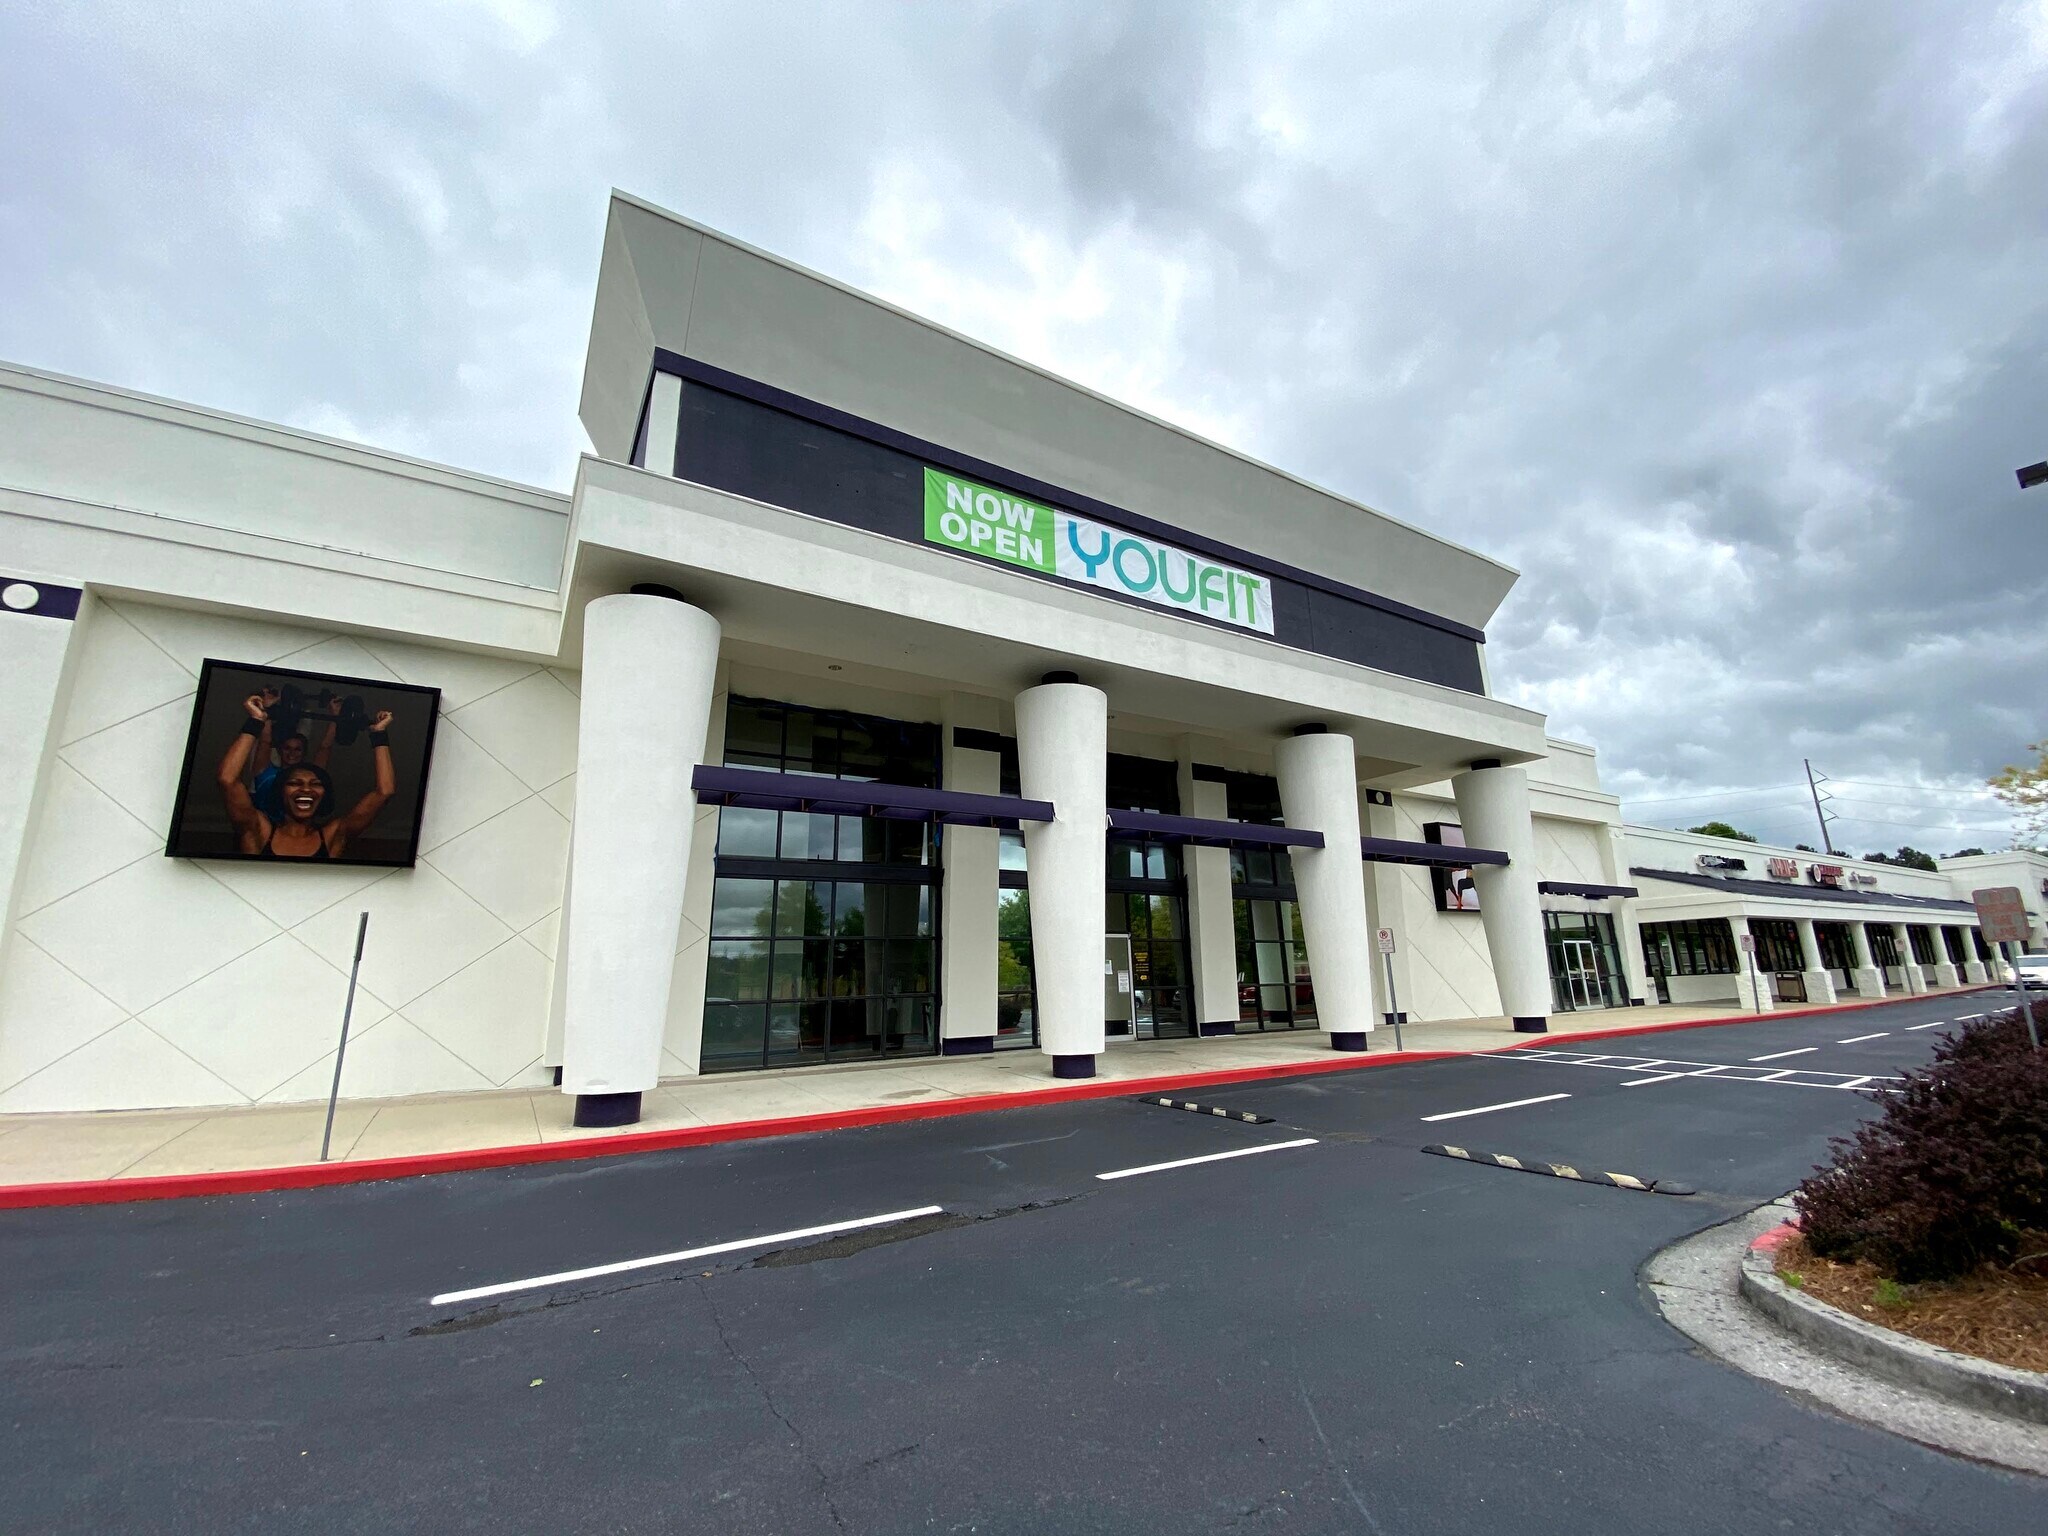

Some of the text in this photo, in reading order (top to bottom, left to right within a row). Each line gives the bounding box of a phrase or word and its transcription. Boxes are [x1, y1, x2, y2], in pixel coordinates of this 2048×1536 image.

[946, 481, 1034, 533] NOW
[939, 512, 1043, 566] OPEN
[1068, 520, 1261, 625] YOUFIT
